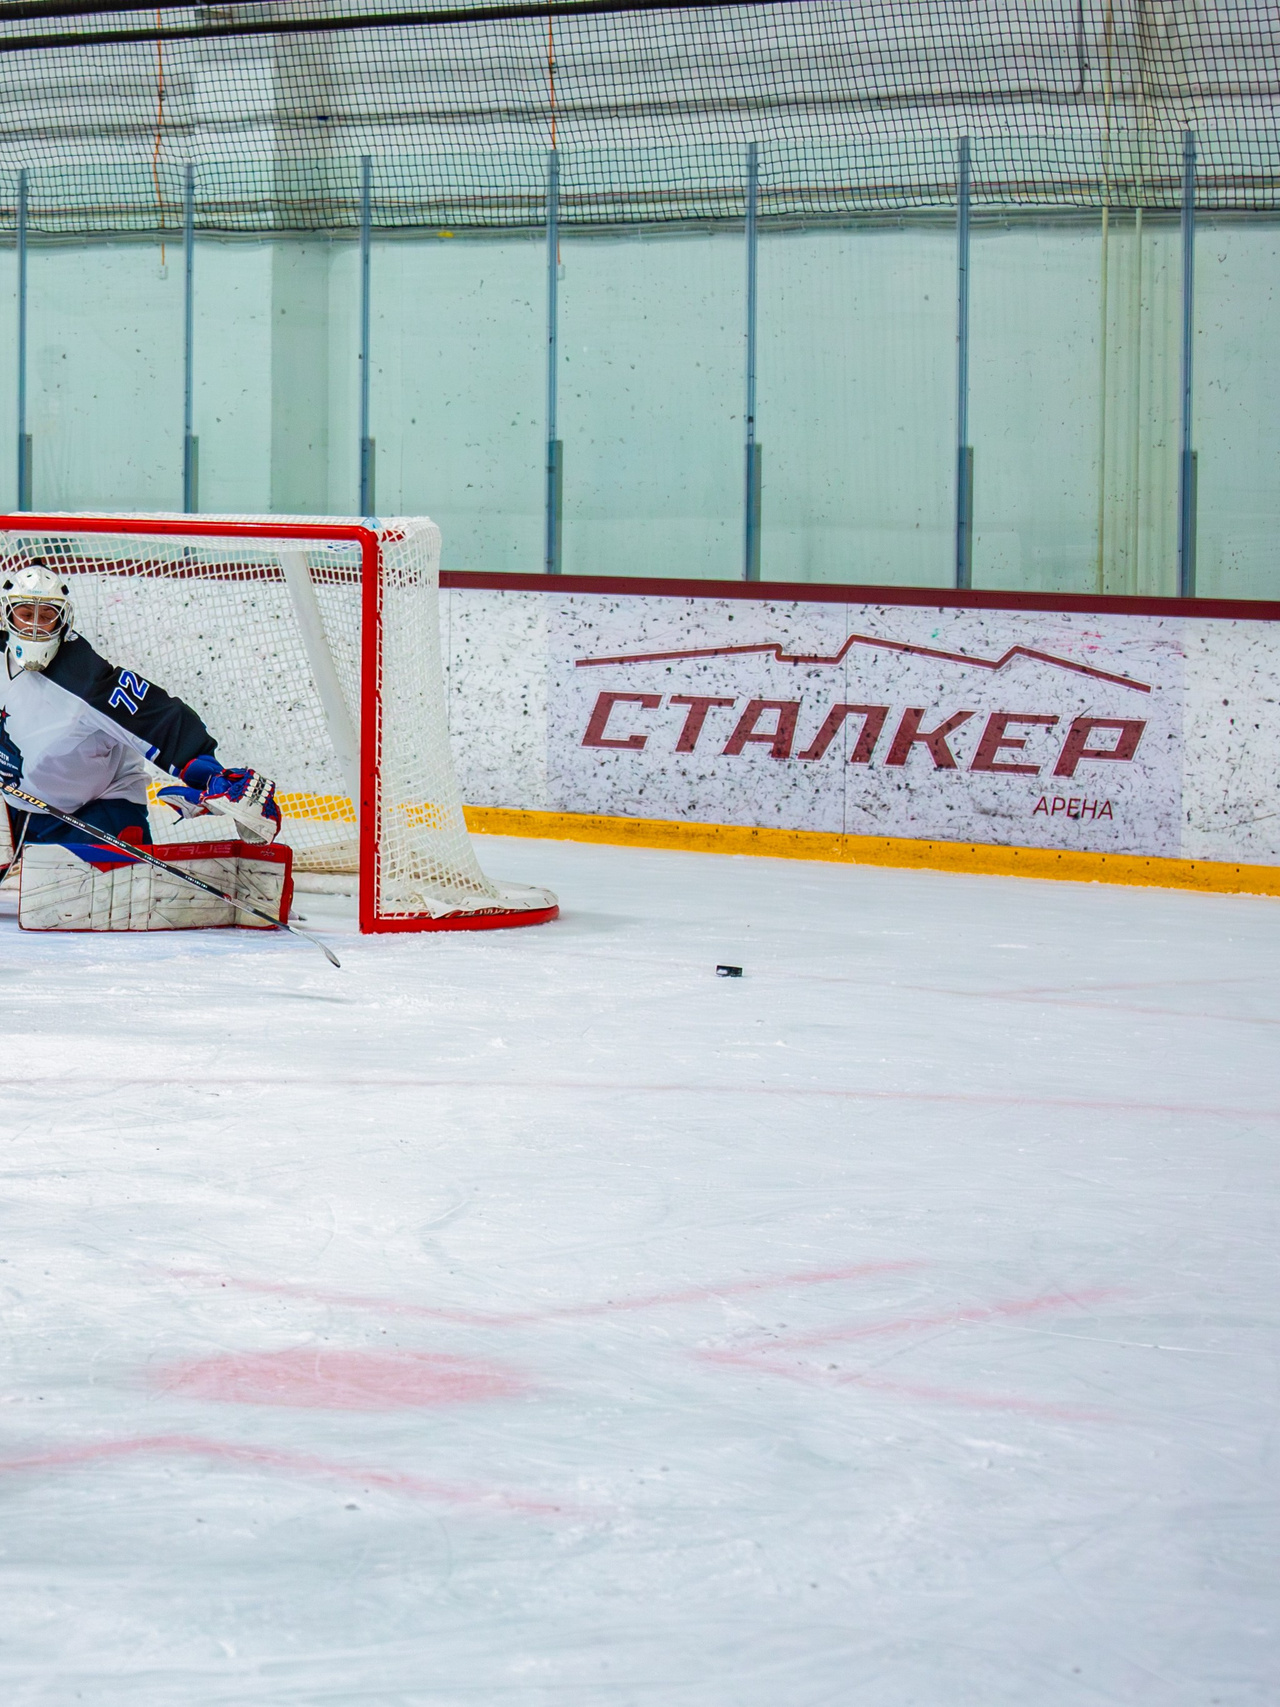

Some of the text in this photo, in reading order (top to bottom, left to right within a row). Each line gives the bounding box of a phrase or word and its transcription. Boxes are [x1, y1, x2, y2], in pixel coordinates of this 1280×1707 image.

[108, 670, 150, 716] 72
[580, 690, 1148, 778] СТАЛКЕР
[4, 785, 48, 809] SOYUZ
[1032, 796, 1114, 820] АРЕНА
